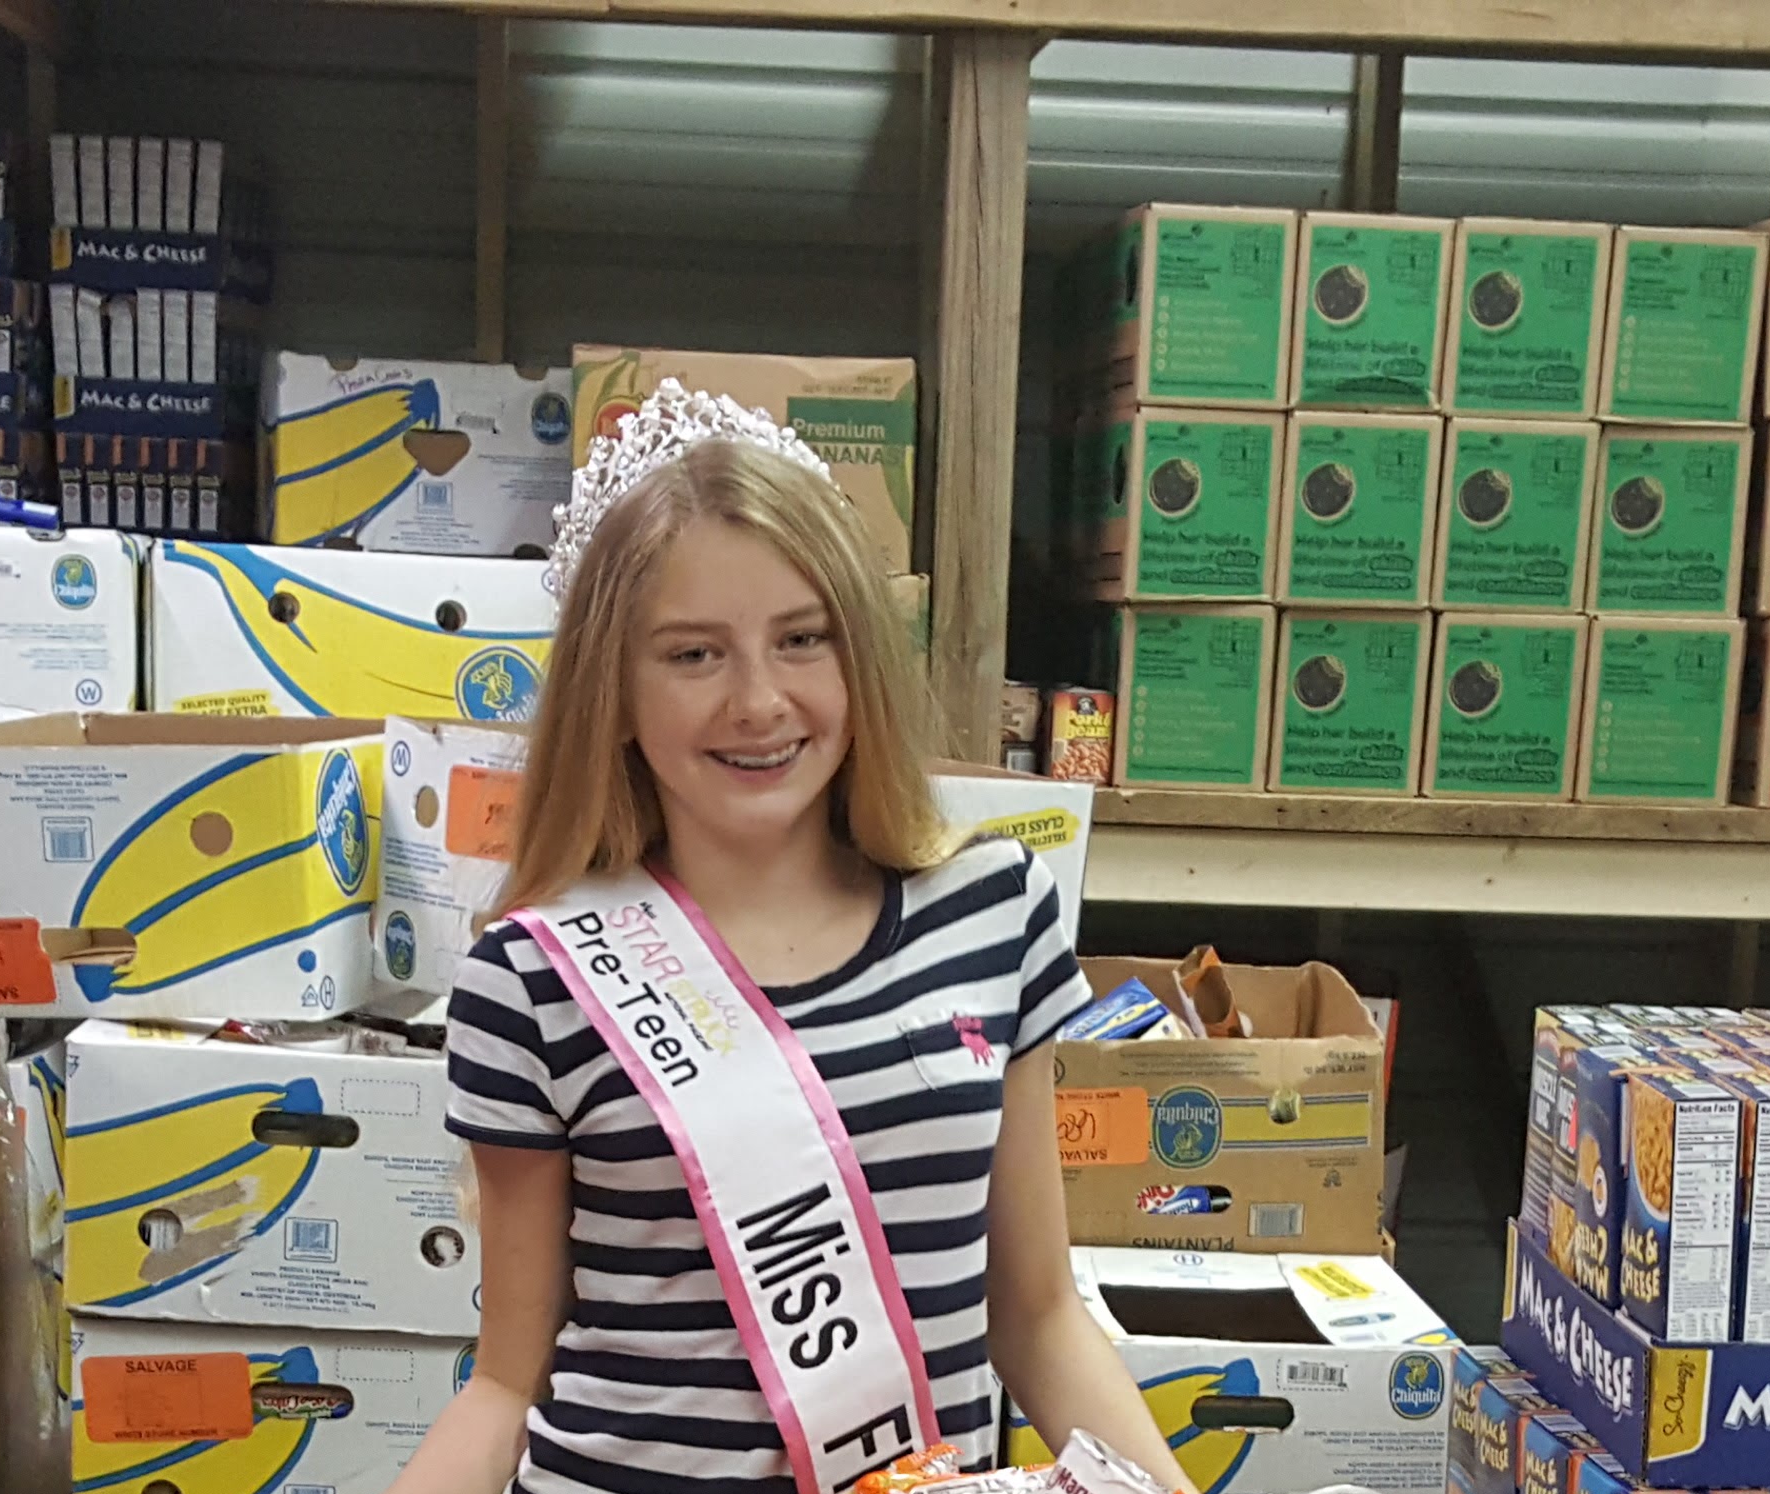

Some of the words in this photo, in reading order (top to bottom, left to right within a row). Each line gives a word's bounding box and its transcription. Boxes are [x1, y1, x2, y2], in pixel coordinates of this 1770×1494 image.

[558, 911, 699, 1087] Pre-Teen
[607, 905, 685, 984] STAR
[736, 1182, 857, 1369] Miss
[125, 1359, 197, 1373] SALVAGE
[1519, 1256, 1554, 1335] MAC
[1569, 1305, 1634, 1414] CHEESE
[1391, 1386, 1442, 1404] Chiquita
